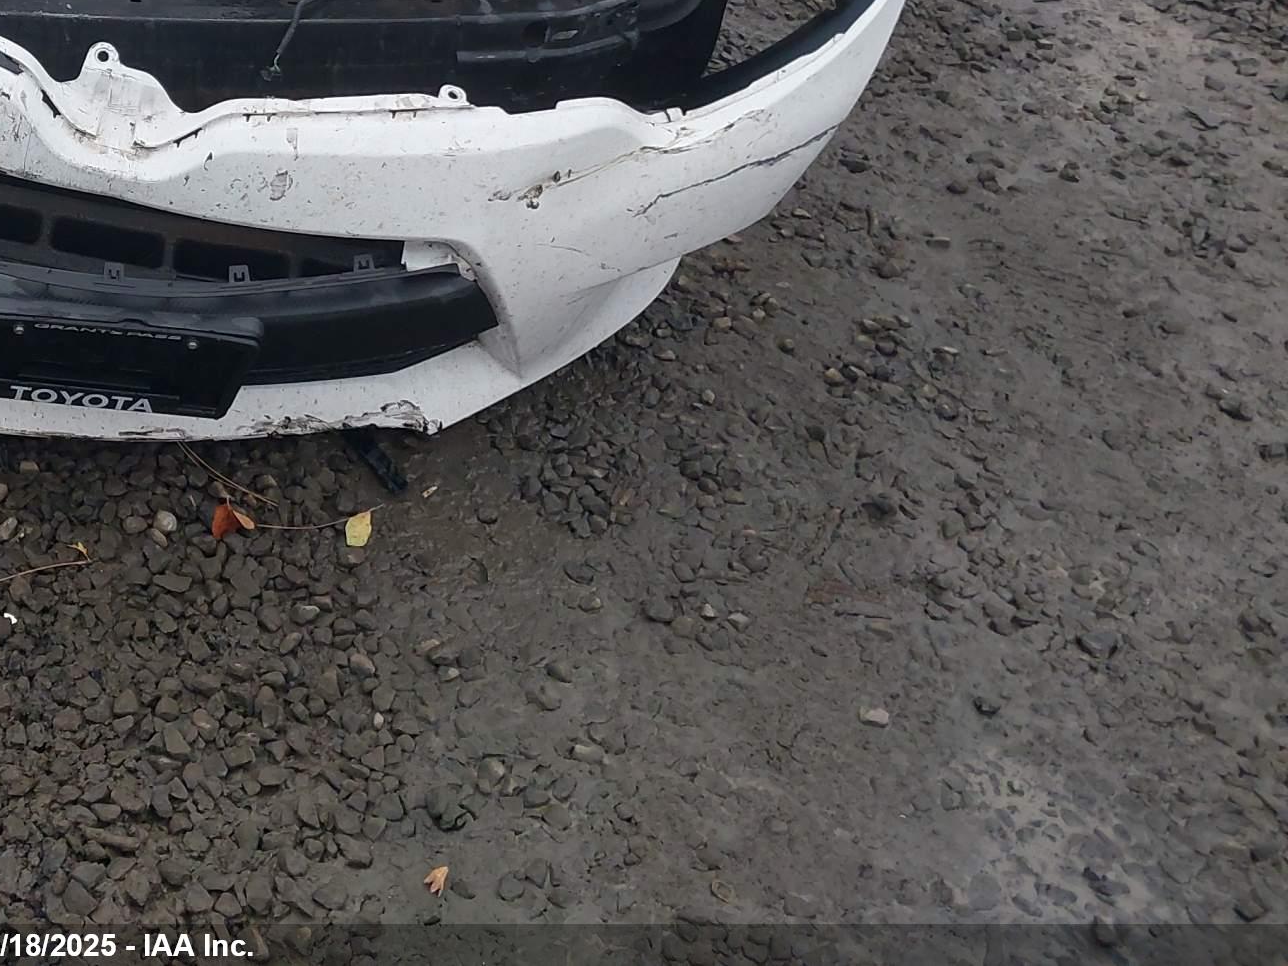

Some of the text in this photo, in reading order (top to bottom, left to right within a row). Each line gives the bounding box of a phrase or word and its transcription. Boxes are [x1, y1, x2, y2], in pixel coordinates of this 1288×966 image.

[34, 323, 182, 340] GRANTS PASS
[10, 386, 152, 413] TOYOTA
